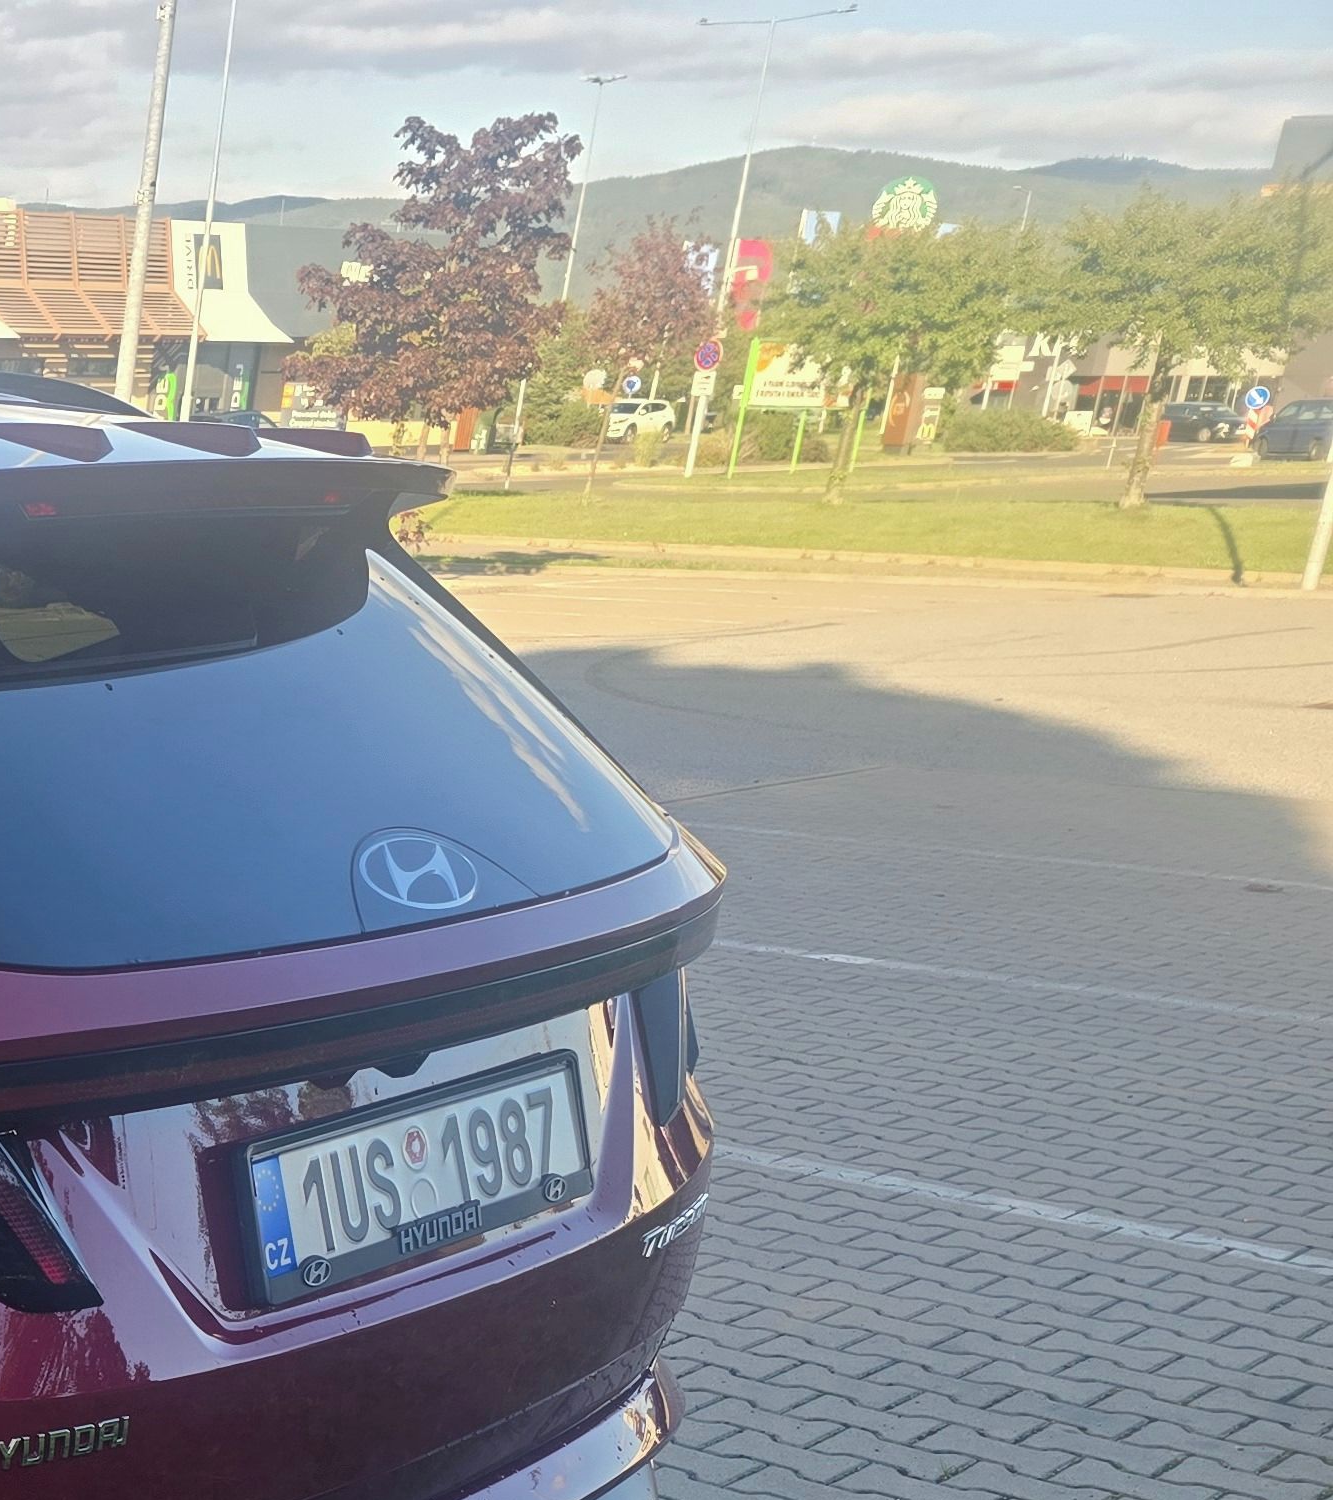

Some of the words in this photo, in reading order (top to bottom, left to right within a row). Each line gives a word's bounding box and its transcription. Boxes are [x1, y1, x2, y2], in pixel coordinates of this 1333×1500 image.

[302, 1138, 402, 1252] 1US
[440, 1085, 553, 1206] 1987
[264, 1237, 292, 1271] CZ
[400, 1203, 483, 1254] HYUNDAI
